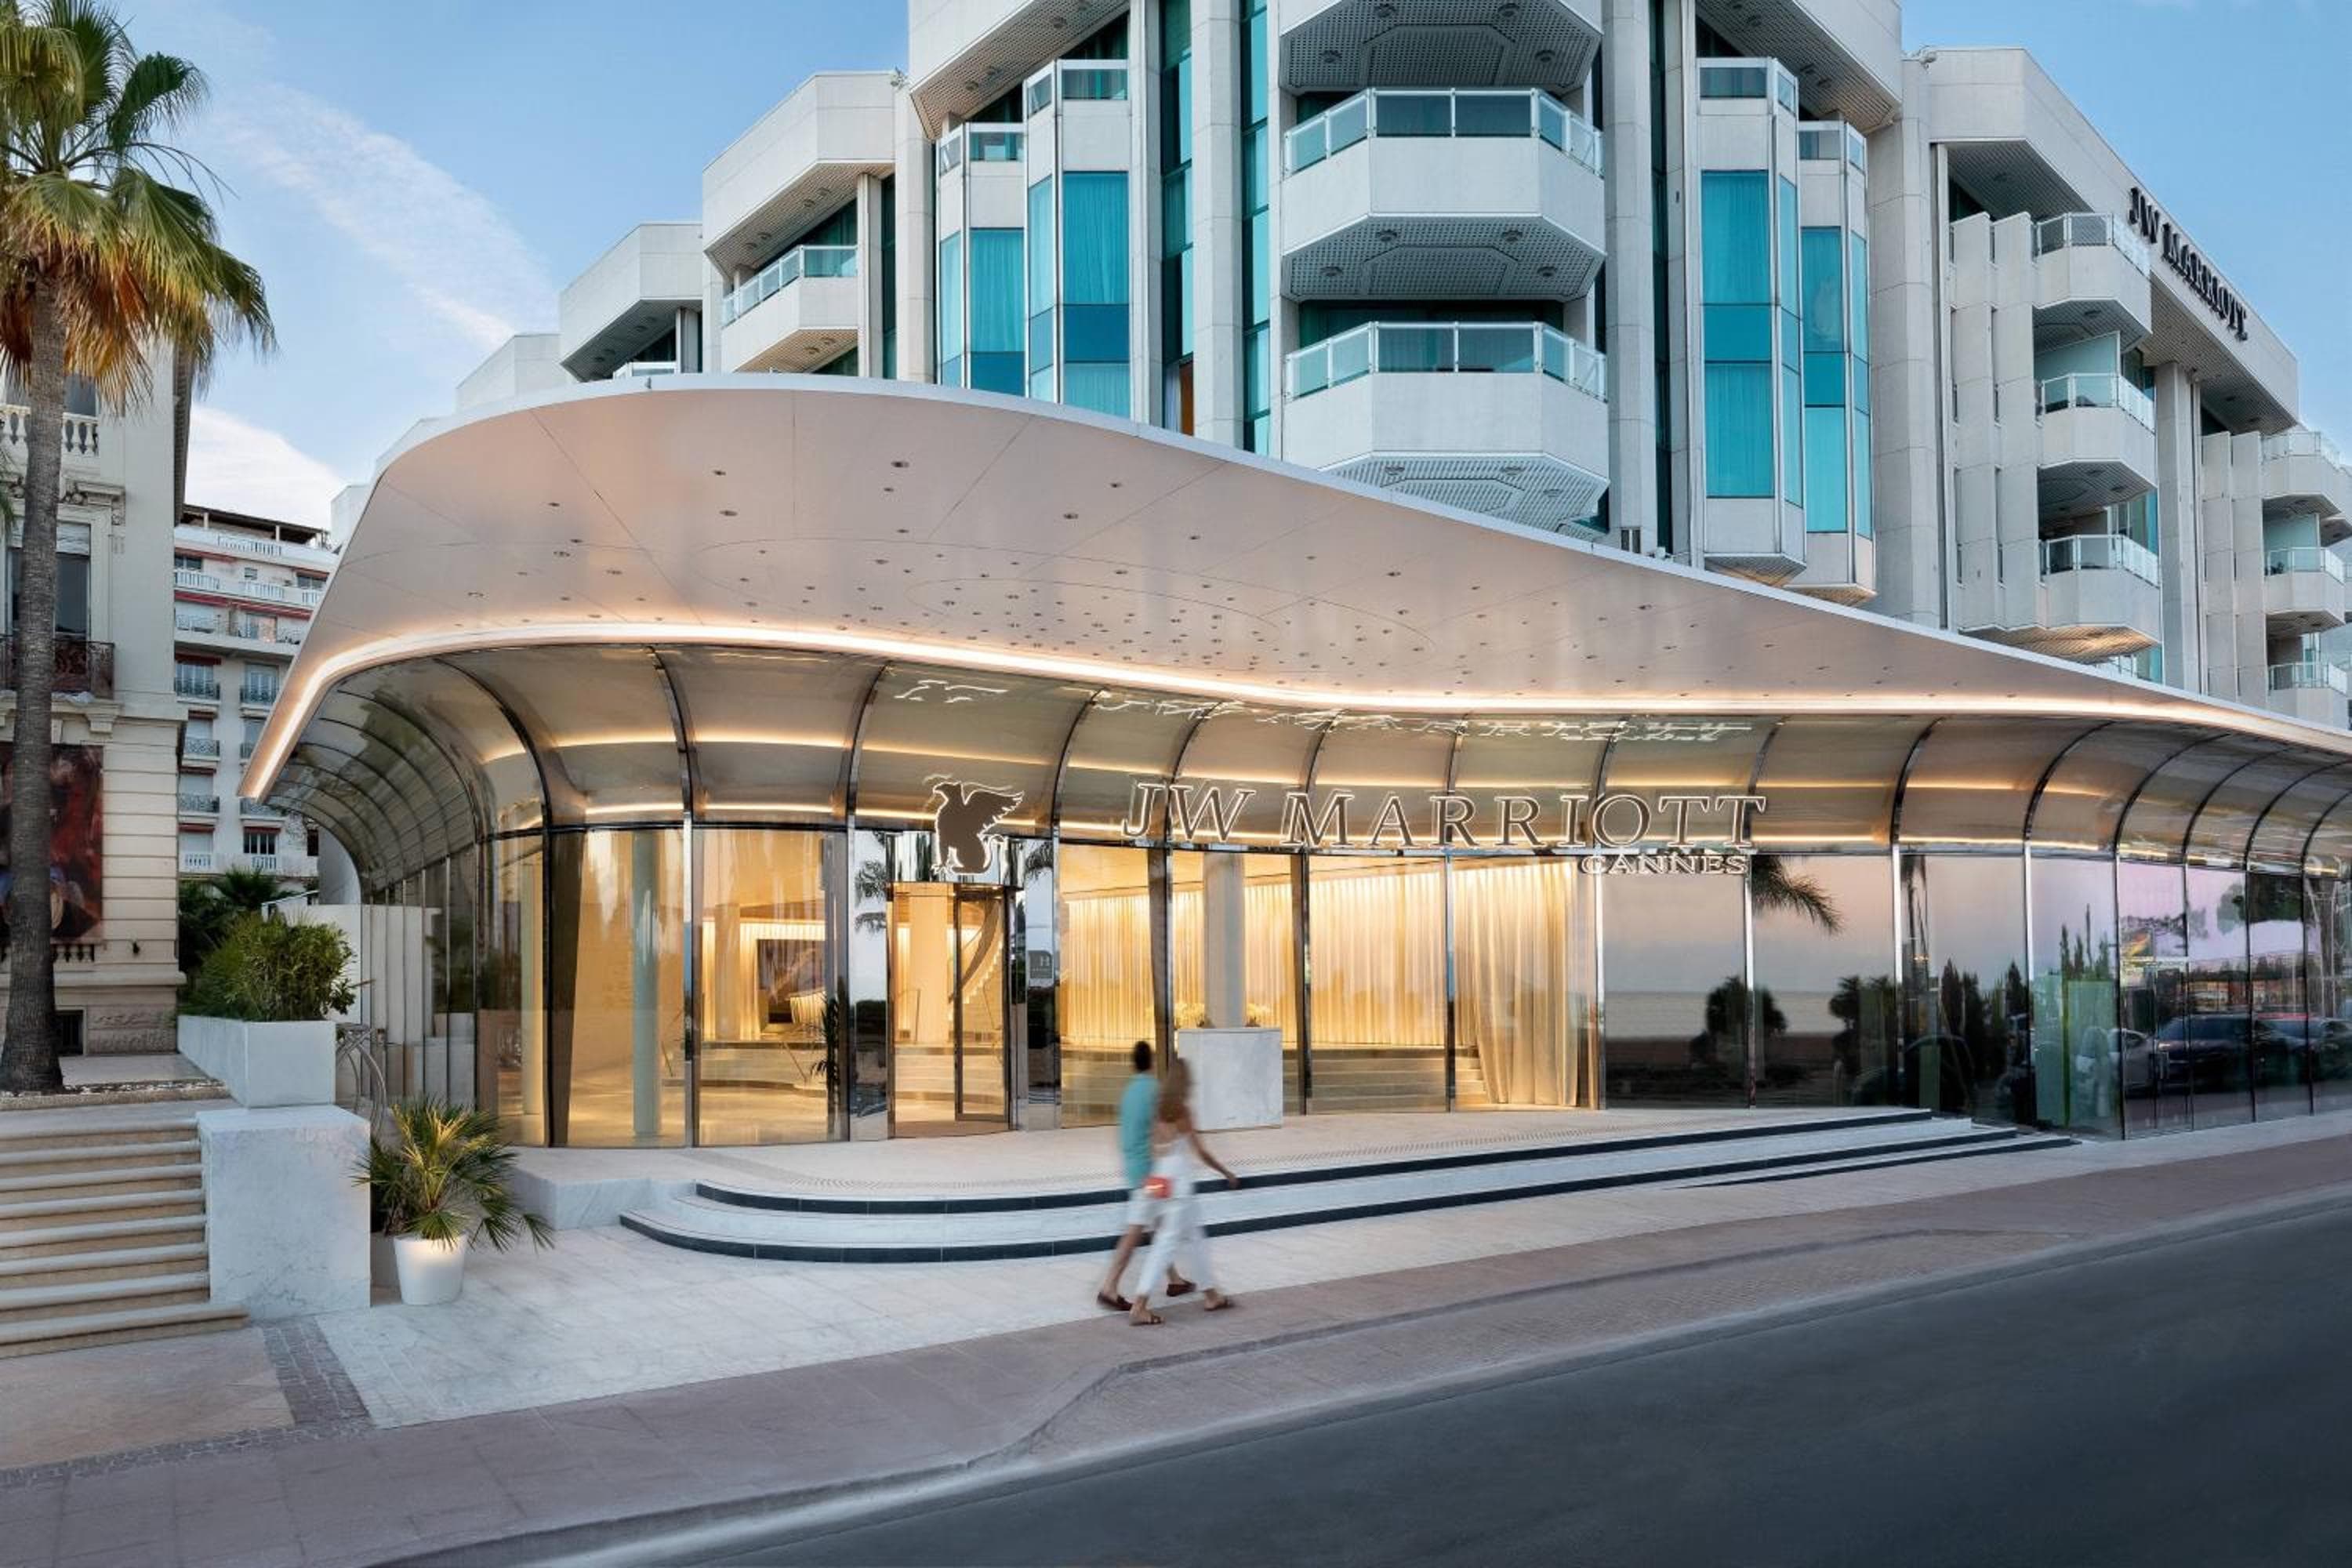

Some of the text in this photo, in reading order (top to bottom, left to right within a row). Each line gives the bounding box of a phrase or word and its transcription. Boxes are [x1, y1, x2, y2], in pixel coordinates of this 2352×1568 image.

[2129, 187, 2160, 243] JW
[1122, 782, 1766, 848] JW MARRIOTT
[1581, 855, 1748, 875] CANNES
